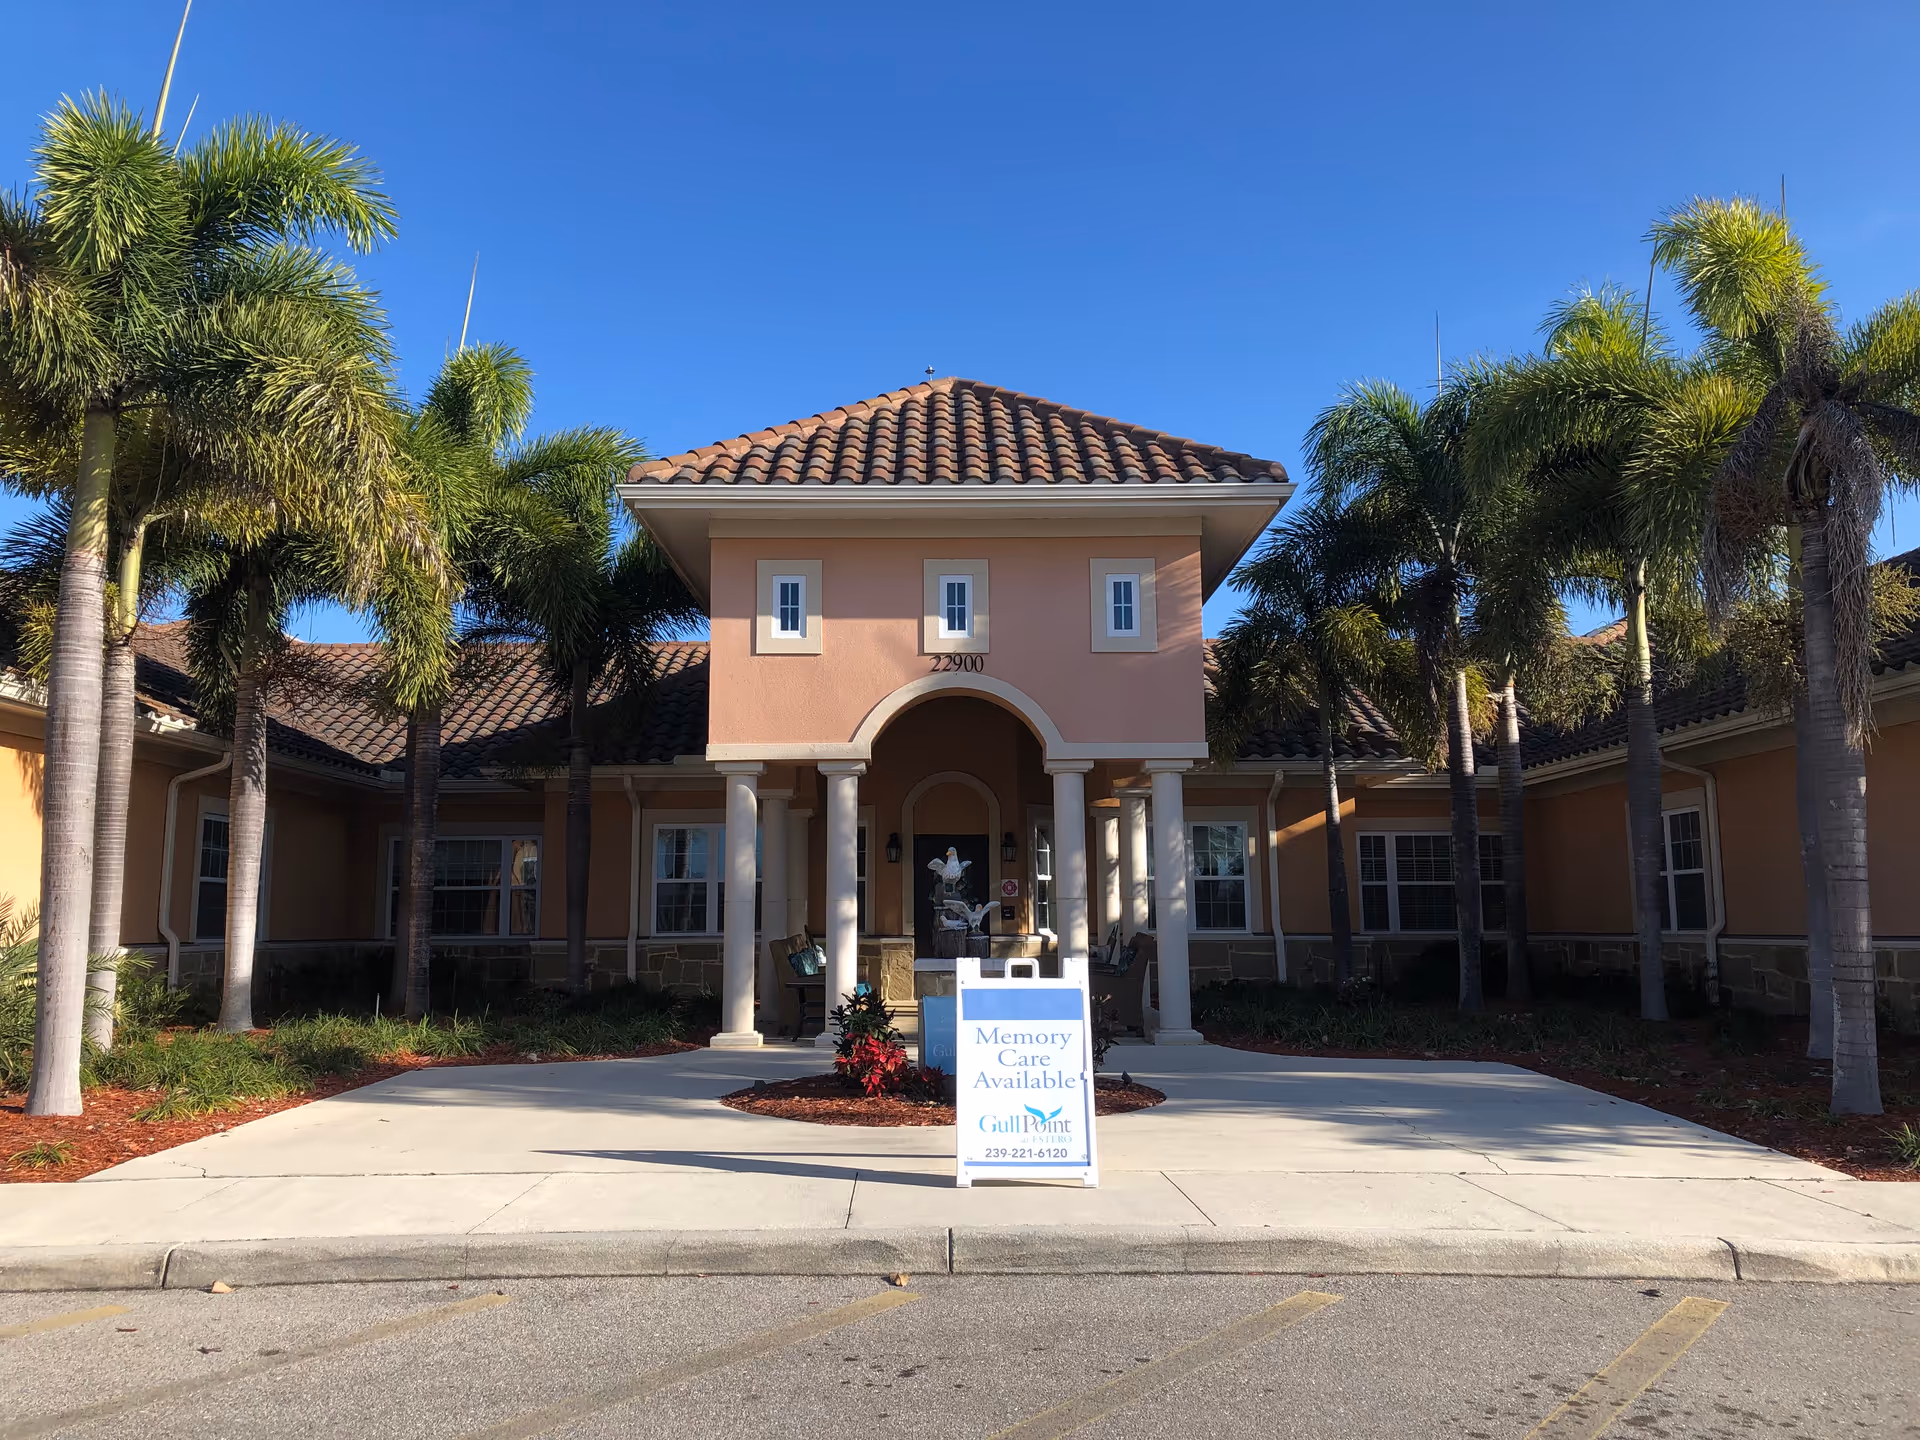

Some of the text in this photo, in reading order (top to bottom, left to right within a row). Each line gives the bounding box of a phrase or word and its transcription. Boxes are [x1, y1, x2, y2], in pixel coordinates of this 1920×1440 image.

[928, 653, 984, 673] 22900
[975, 1026, 1073, 1050] Memory
[997, 1048, 1051, 1067] Care
[973, 1070, 1076, 1089] Available
[985, 1148, 1068, 1158] 239-221-6120
